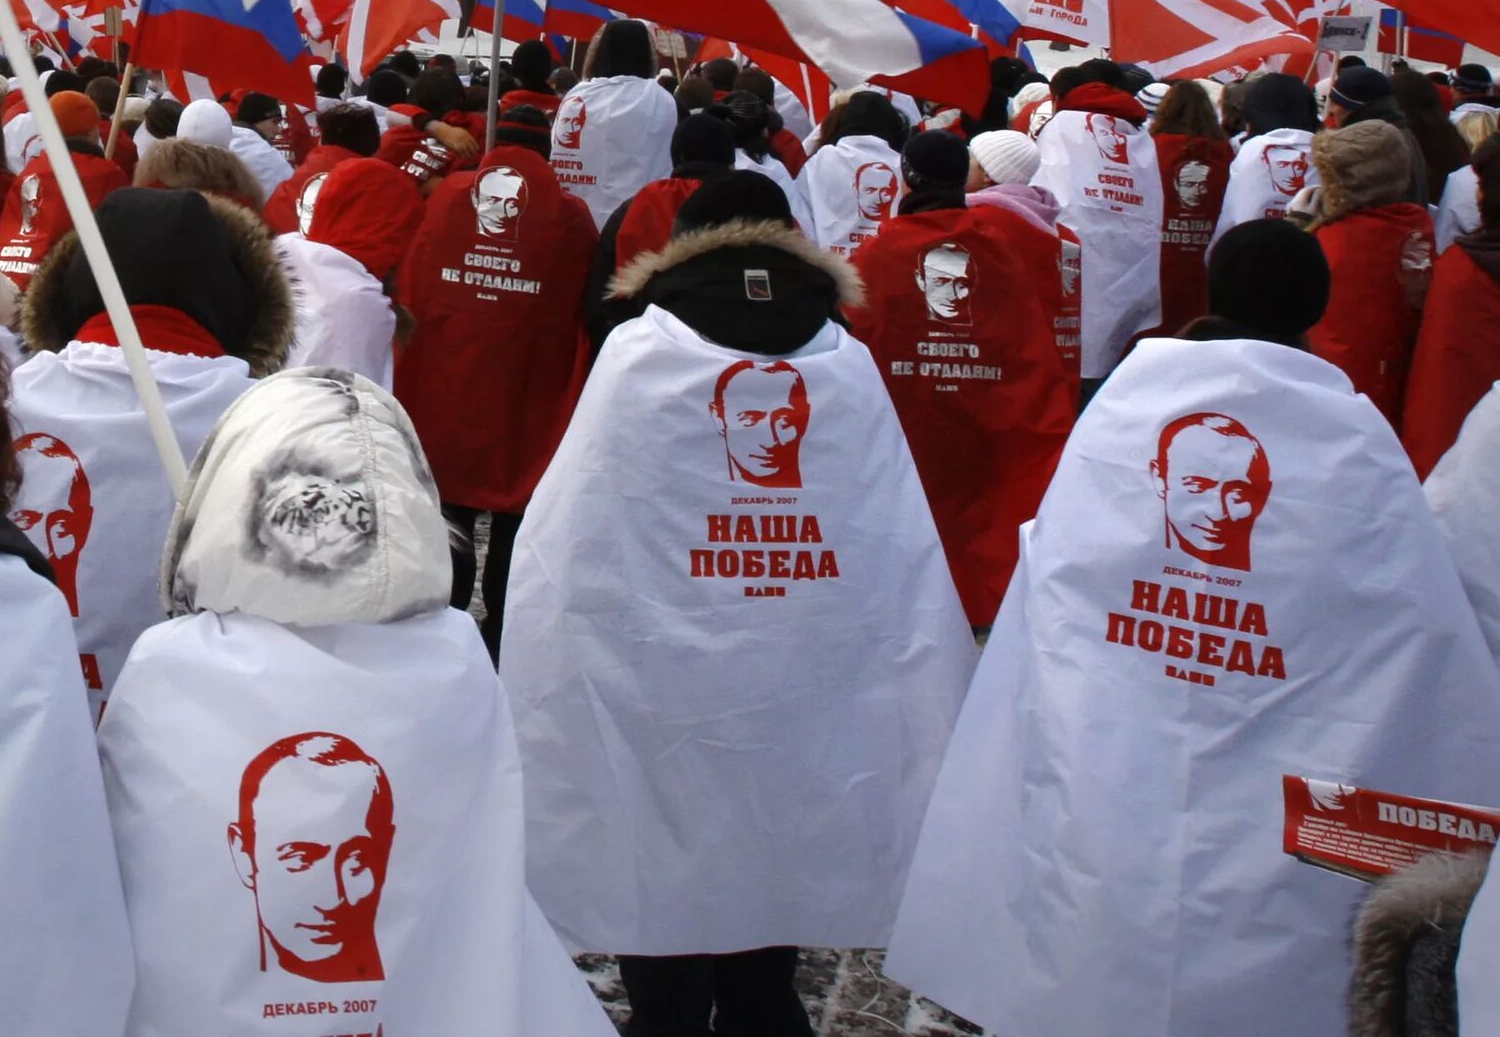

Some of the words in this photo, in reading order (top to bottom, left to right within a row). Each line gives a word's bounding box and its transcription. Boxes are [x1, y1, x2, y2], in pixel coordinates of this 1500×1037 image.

[550, 159, 583, 170] ВОЕГО
[464, 252, 521, 273] СВОЕГО
[442, 268, 461, 283] НЕ
[464, 271, 541, 294] ОТДАДИМ!
[917, 342, 980, 359] СВОЕГО
[891, 361, 914, 376] НЕ
[920, 362, 1002, 380] ОТДАДИМ!
[731, 496, 773, 505] ДЕКАБРЬ
[776, 497, 798, 505] 2007
[707, 514, 823, 543] НАША
[689, 549, 840, 581] ПОБЕДА
[1162, 565, 1213, 583] ДЕКАБРЬ
[1215, 575, 1243, 588] 2007
[1130, 579, 1269, 637] НАША
[1105, 612, 1287, 681] ПОБЕДА
[1378, 801, 1498, 844] ПОБЕДА
[263, 1001, 339, 1019] ДЕКАБРЬ
[343, 999, 378, 1014] 2007
